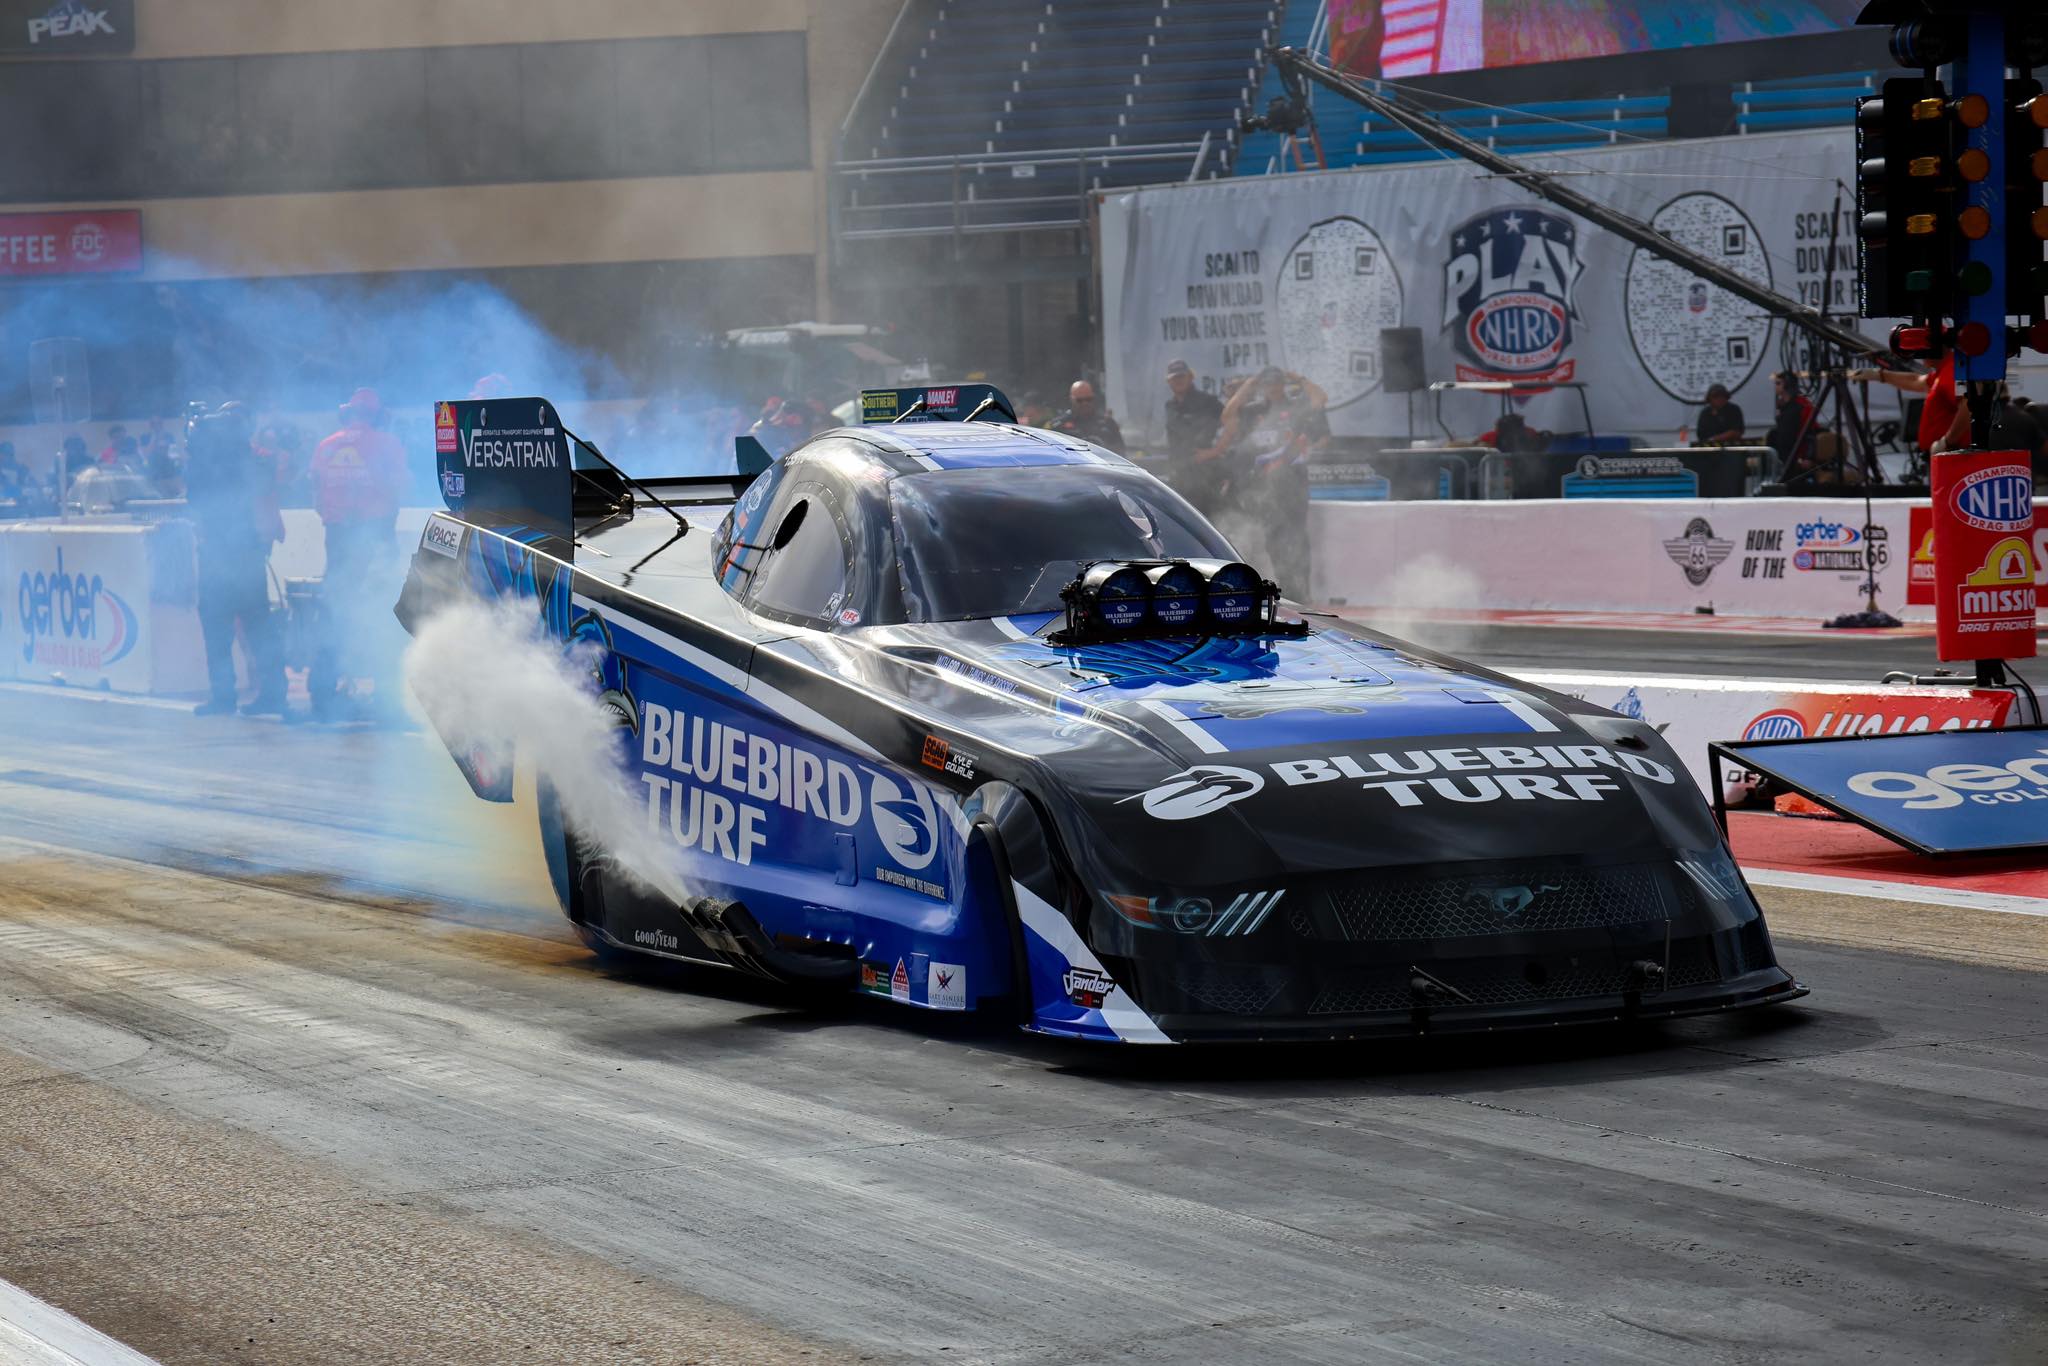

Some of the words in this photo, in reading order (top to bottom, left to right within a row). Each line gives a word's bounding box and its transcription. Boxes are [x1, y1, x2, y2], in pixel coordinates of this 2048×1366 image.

[28, 9, 116, 44] PEAK
[71, 233, 105, 252] FDC
[1242, 250, 1260, 274] TO
[1443, 234, 1581, 327] PLAY
[1798, 280, 1845, 306] YOR
[1161, 316, 1199, 341] YOUR
[1485, 308, 1554, 350] NHRA
[1224, 344, 1250, 368] APP
[863, 394, 896, 408] SOUTHERN
[927, 390, 957, 405] MANLEY
[460, 429, 556, 467] VERSATRAN
[1796, 517, 1842, 547] gerber
[1970, 518, 2003, 530] DRAG
[1745, 530, 1784, 550] HOME
[1690, 547, 1706, 565] 66
[1741, 557, 1757, 578] OF
[1762, 557, 1786, 578] THE
[1859, 581, 1882, 596] PEK
[19, 546, 103, 664] gerber
[1105, 612, 1141, 620] BLUEBIRD
[1214, 606, 1249, 614] BLUEBIRD
[1957, 622, 1991, 633] DRAG
[1993, 619, 2029, 632] RACING
[643, 702, 862, 827] BLUEBIRD
[945, 761, 974, 779] GOURLIE
[953, 753, 973, 768] KYLE
[1269, 745, 1675, 785] BLUEBIRD
[1363, 774, 1620, 806] TURF
[641, 772, 766, 866] TURF
